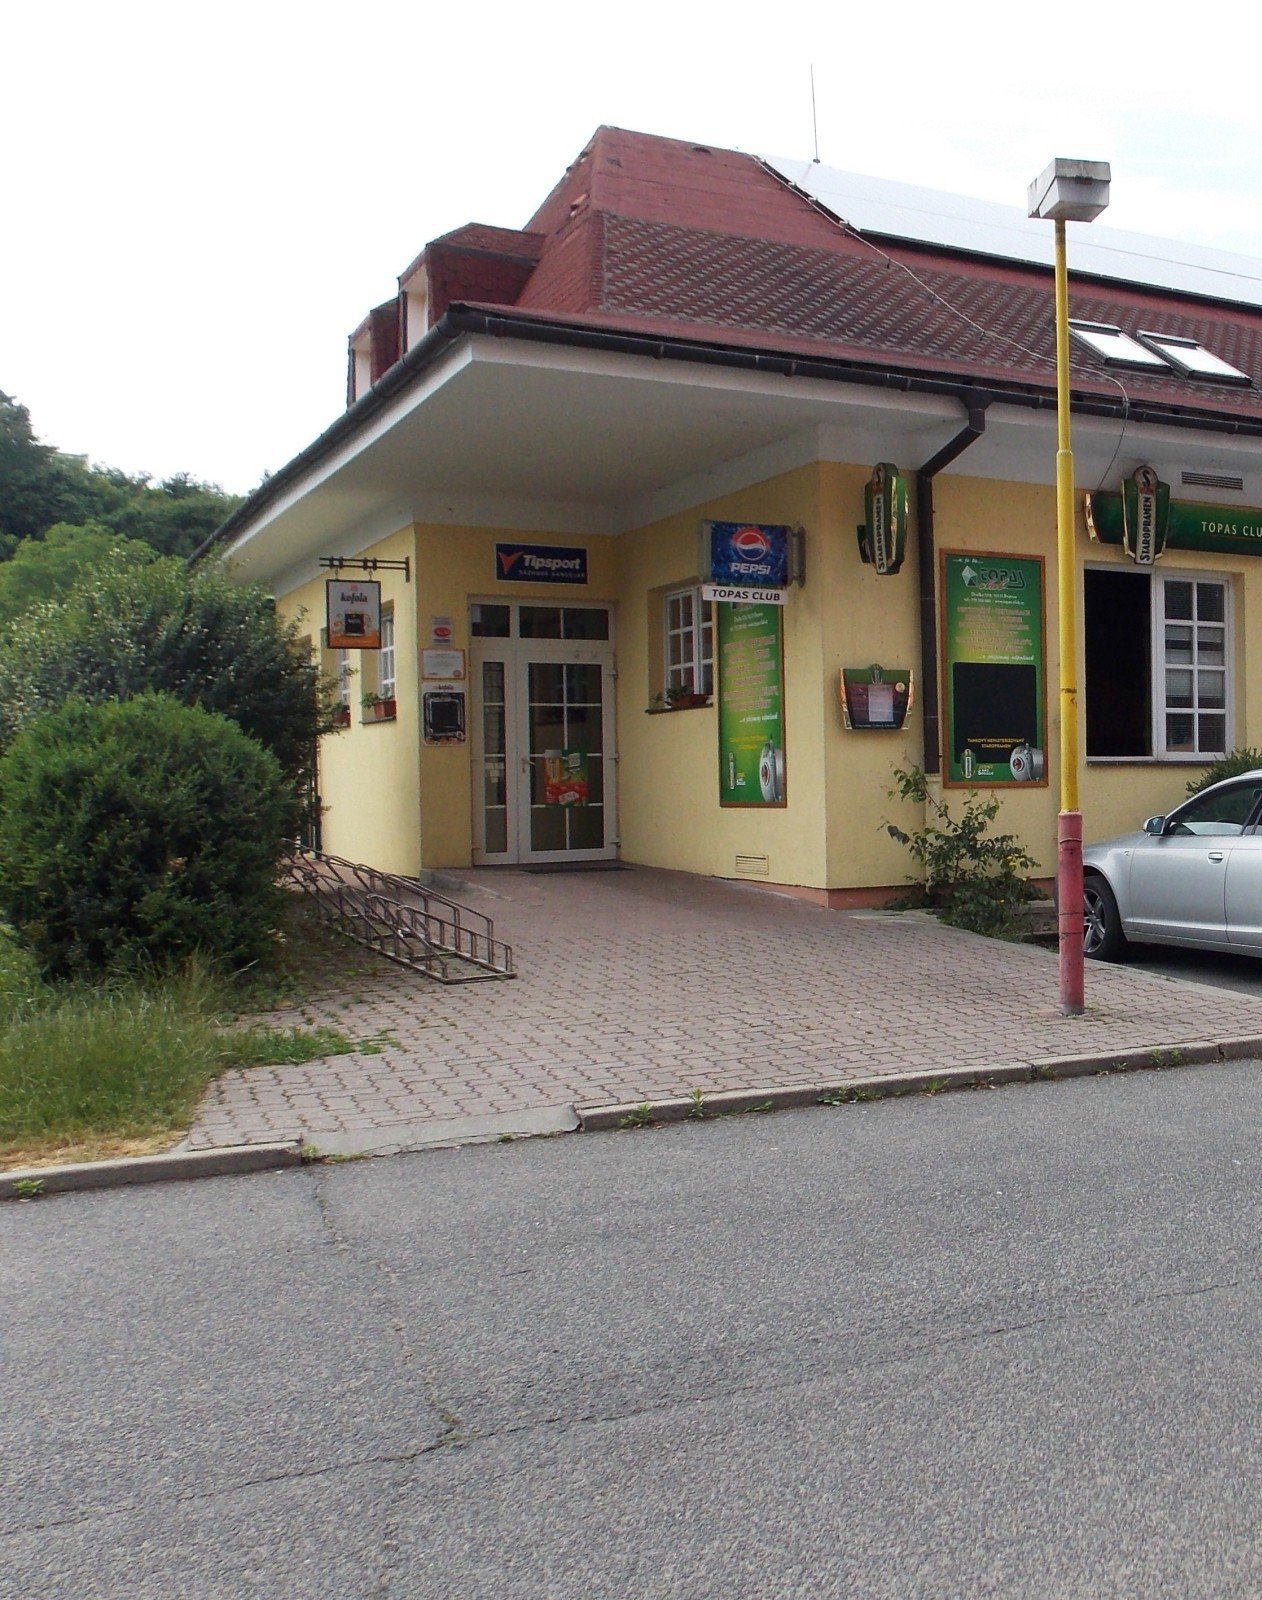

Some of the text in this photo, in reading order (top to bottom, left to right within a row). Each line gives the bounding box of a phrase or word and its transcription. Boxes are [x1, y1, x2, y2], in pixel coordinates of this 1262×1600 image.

[1140, 496, 1152, 562] STAROPRAMEN
[1201, 521, 1237, 535] TOPAS
[523, 555, 581, 571] Tipsport
[730, 562, 772, 575] PEPSI
[712, 589, 781, 601] TOPAS CLUB
